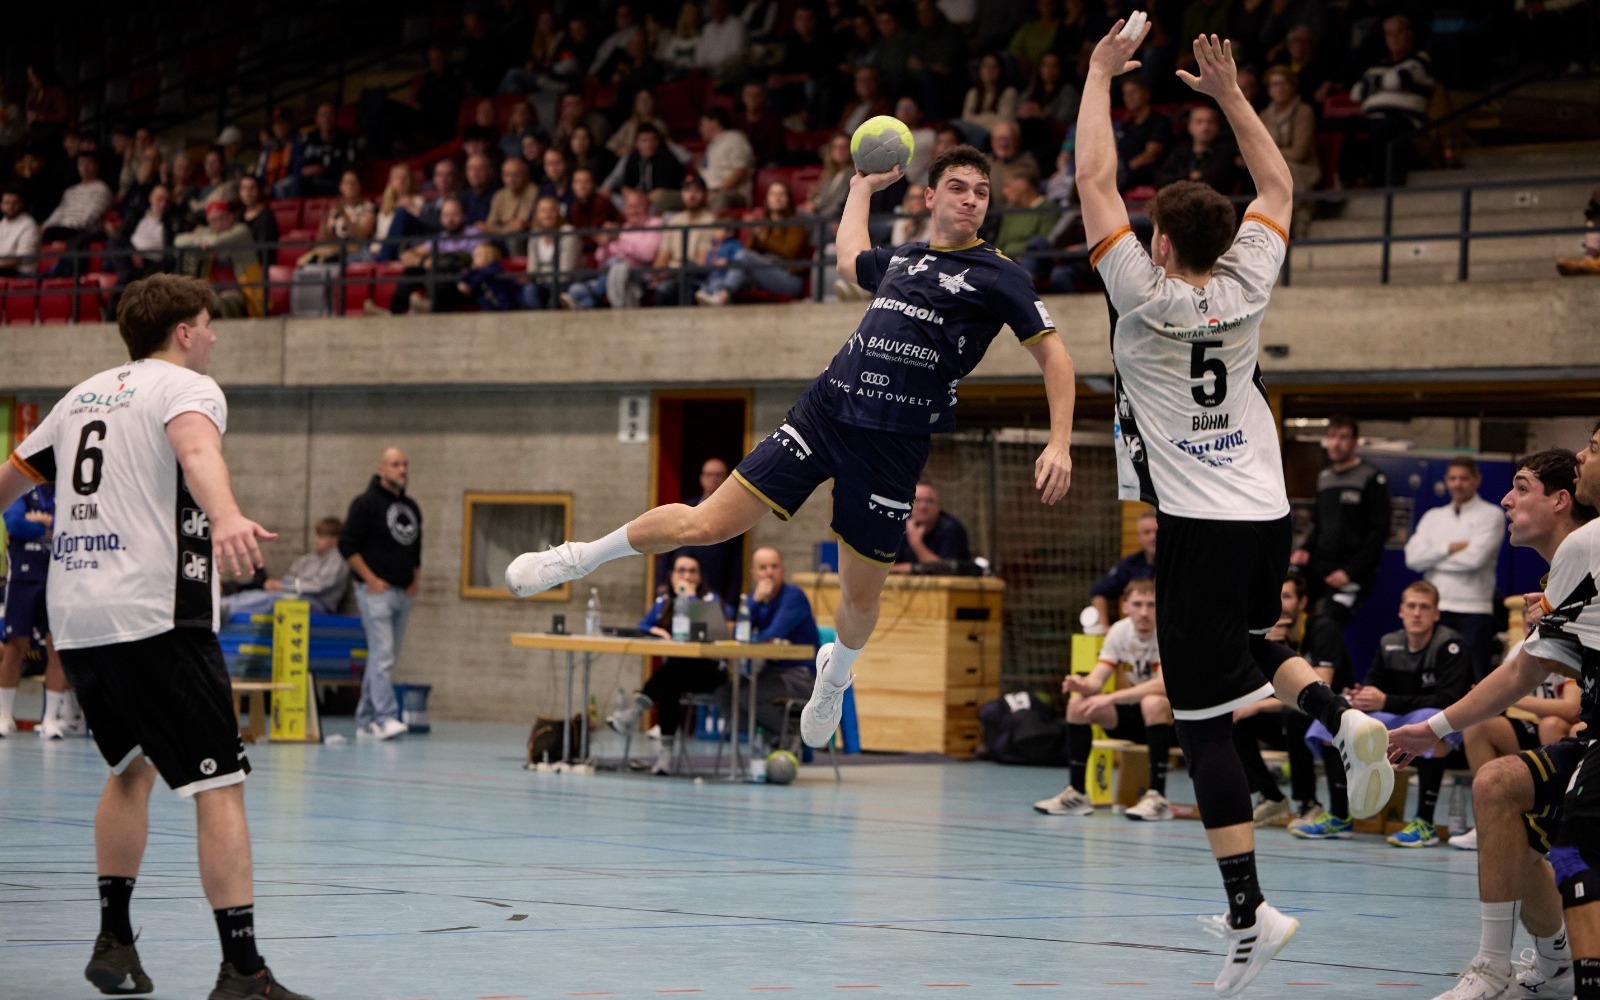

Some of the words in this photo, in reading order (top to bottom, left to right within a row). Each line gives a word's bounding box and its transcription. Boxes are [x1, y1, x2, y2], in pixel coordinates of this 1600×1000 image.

[867, 336, 940, 362] BAUVEREIN
[903, 357, 928, 368] Gmünd
[1190, 340, 1227, 408] 5
[856, 388, 932, 406] AUTOWELT
[1192, 412, 1229, 431] BÖHM
[72, 420, 107, 496] 6
[71, 503, 98, 520] KEIM
[65, 556, 99, 571] Extra
